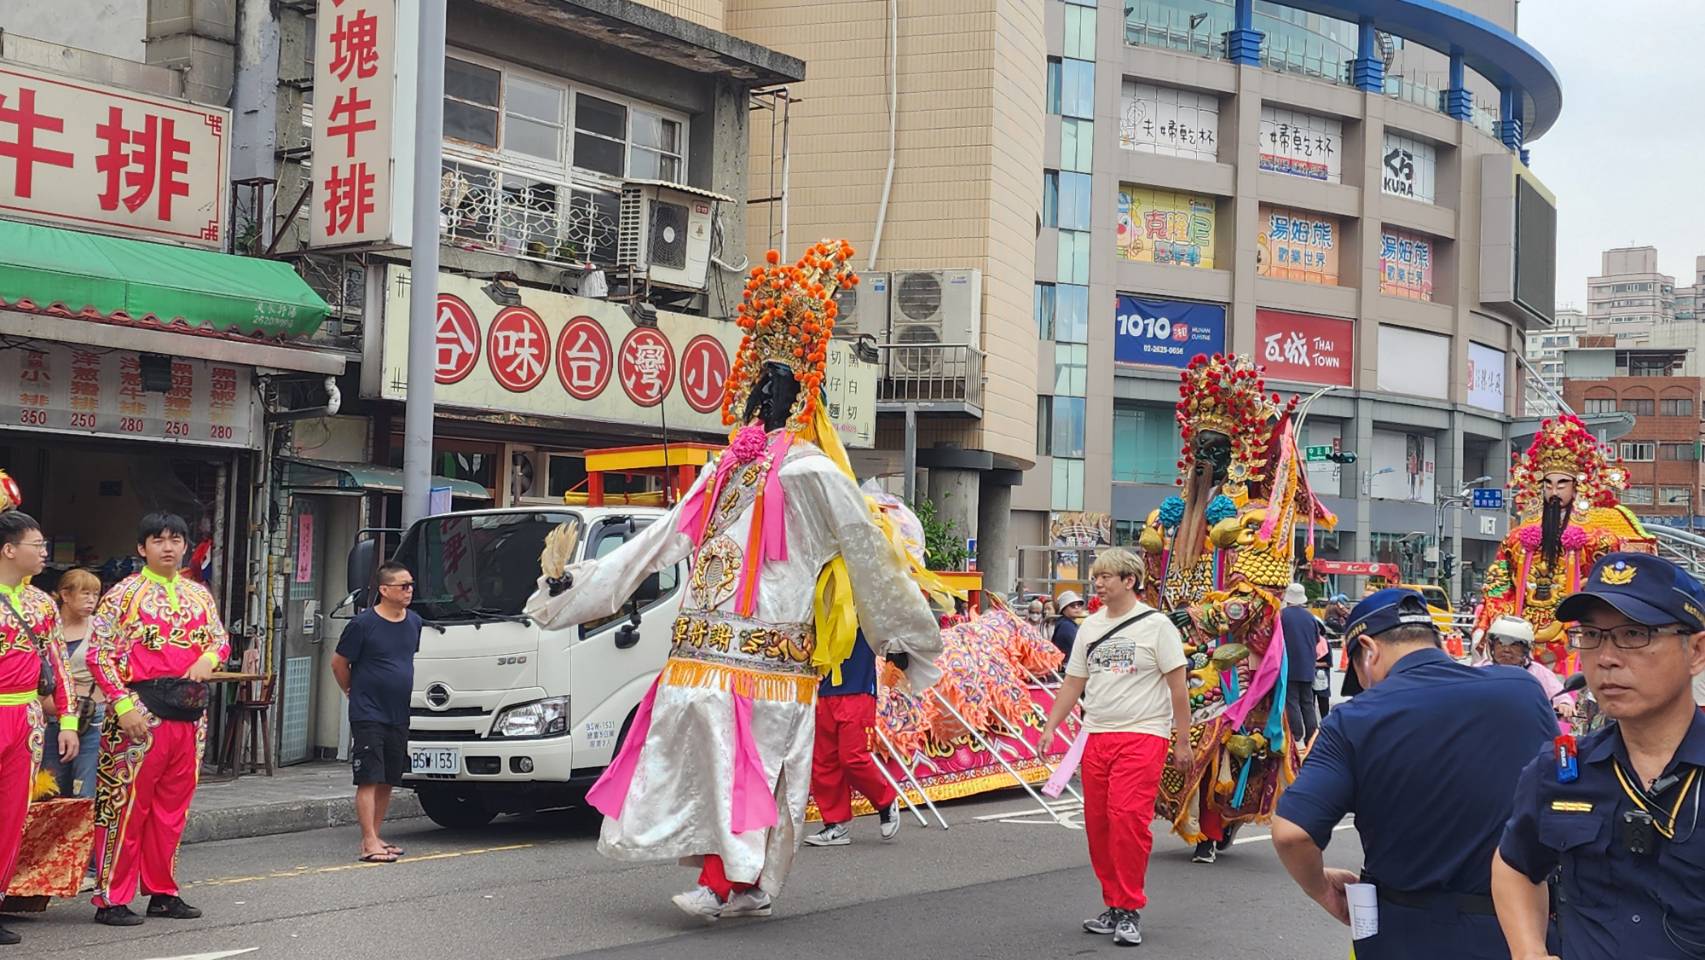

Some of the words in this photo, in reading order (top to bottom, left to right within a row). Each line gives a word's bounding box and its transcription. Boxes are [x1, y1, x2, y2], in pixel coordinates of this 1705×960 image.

[325, 0, 379, 236] 塊牛排
[1384, 149, 1413, 180] くら
[1384, 177, 1413, 197] KURA
[1269, 215, 1332, 248] 湯姆熊
[1381, 234, 1428, 267] 湯姆熊
[1117, 314, 1171, 340] 1010
[1265, 331, 1310, 367] 瓦城
[1313, 337, 1334, 351] THAI
[1312, 353, 1340, 368] TOWN
[21, 409, 47, 425] 350
[71, 412, 96, 428] 250
[120, 417, 144, 432] 280
[165, 420, 189, 436] 250
[211, 425, 232, 440] 280
[497, 656, 527, 665] 300
[412, 752, 457, 769] BSW-1531
